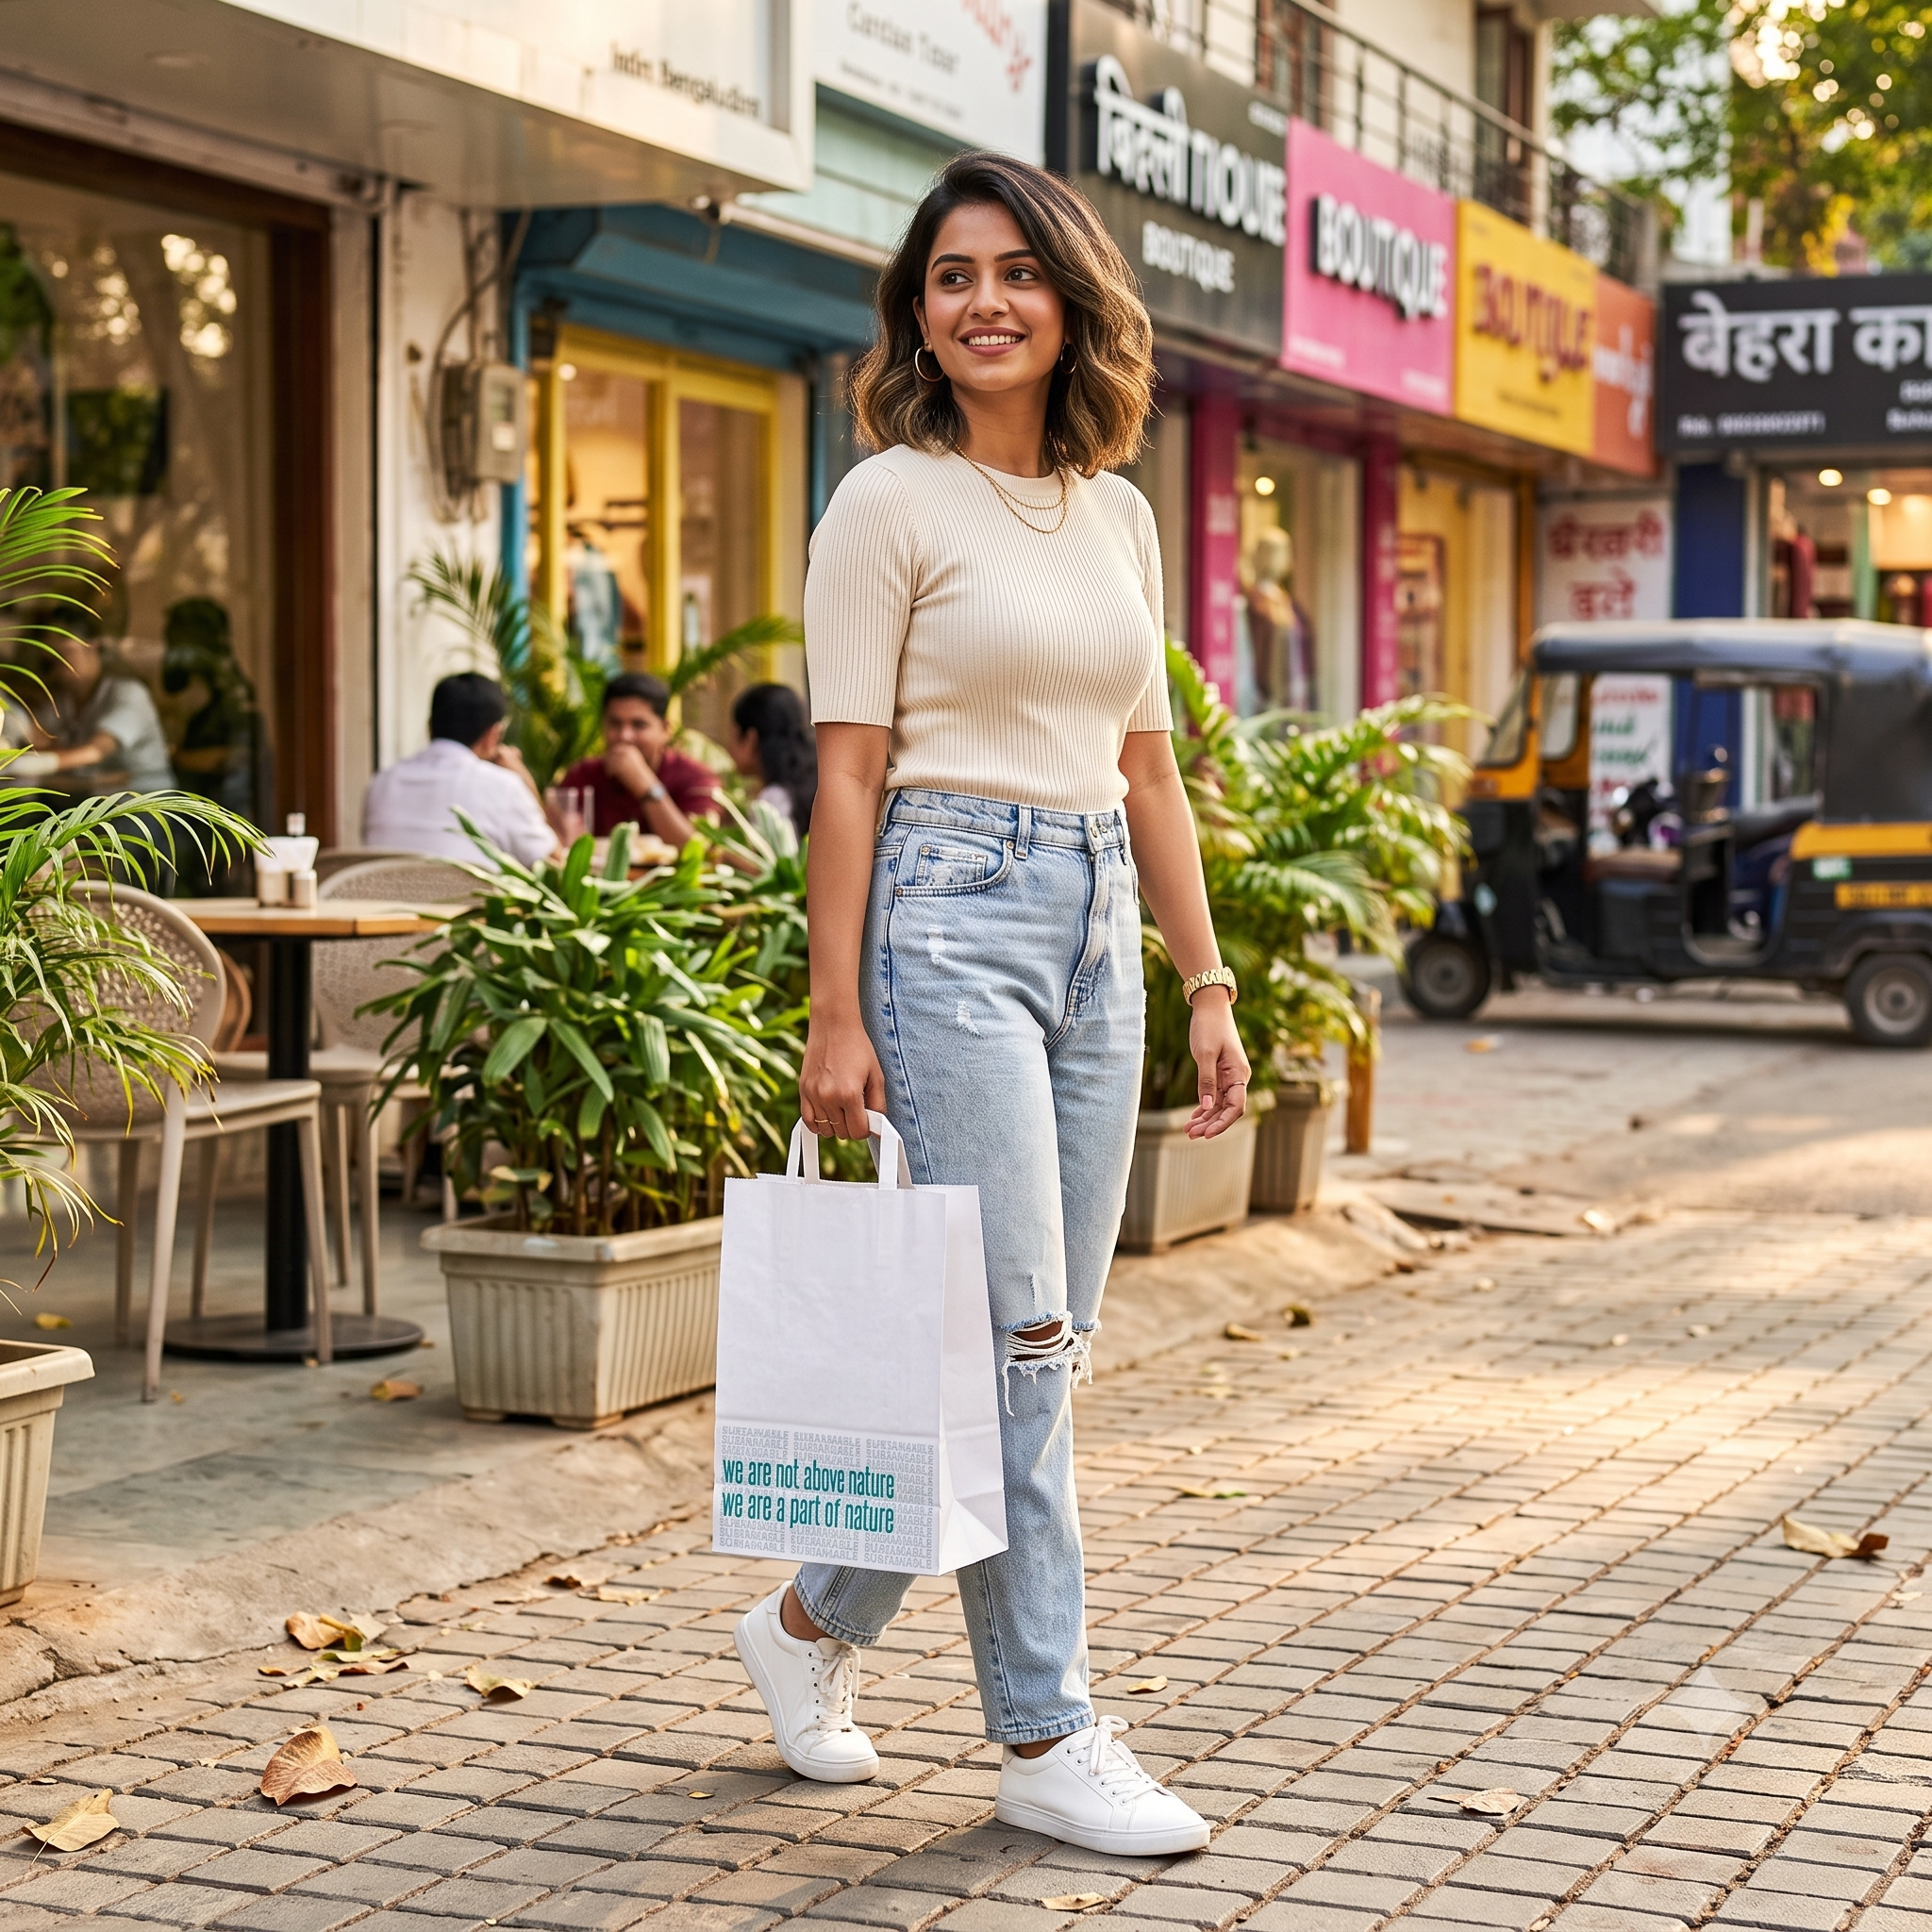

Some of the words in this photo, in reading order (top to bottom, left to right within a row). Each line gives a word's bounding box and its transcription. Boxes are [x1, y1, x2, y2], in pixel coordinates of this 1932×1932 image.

[1141, 220, 1236, 293] BOUTIQUE
[1316, 192, 1448, 321] BOUTIQUE
[722, 1459, 743, 1484] we
[748, 1461, 772, 1487] are
[775, 1458, 800, 1490] not
[804, 1459, 845, 1493] above
[848, 1466, 895, 1499] nature
[722, 1491, 743, 1518] we
[747, 1494, 772, 1521] are
[775, 1496, 786, 1523] a
[789, 1494, 821, 1529] part
[824, 1498, 841, 1528] of
[844, 1499, 894, 1534] nature
